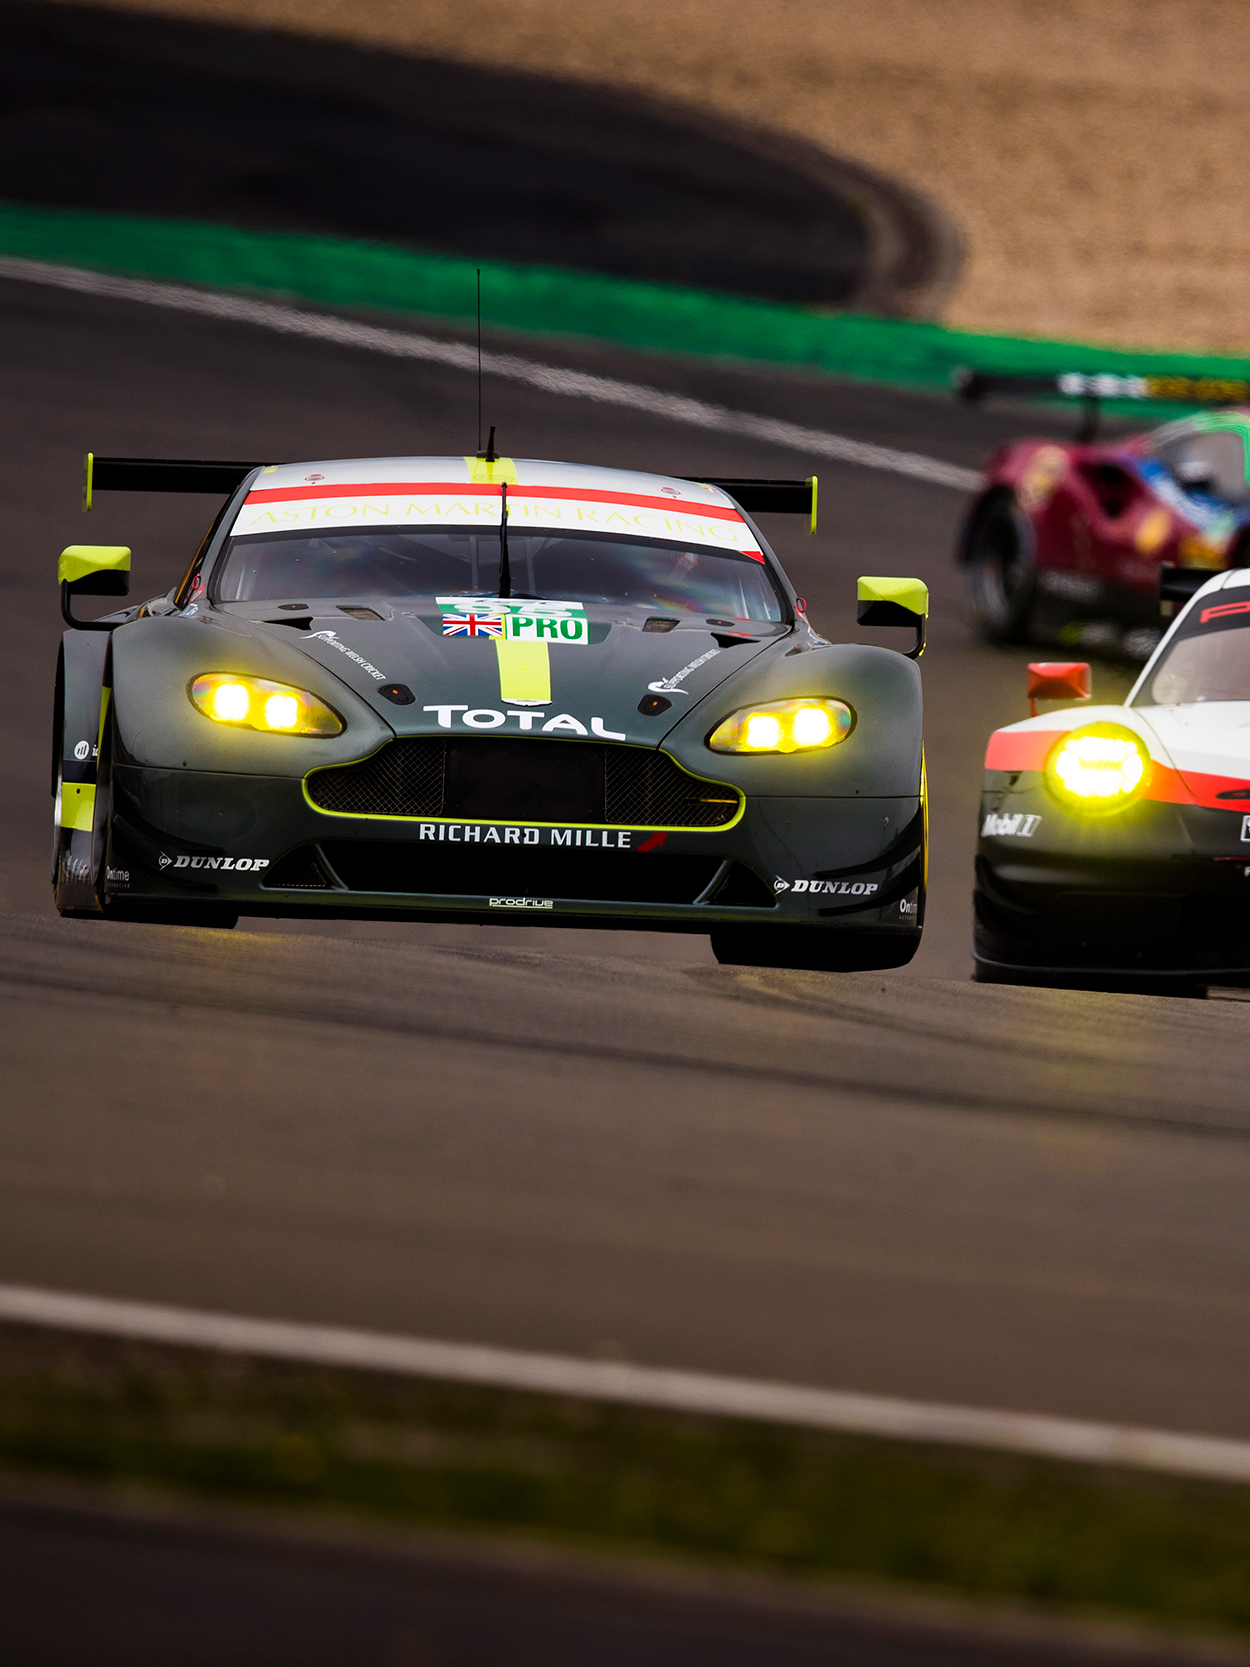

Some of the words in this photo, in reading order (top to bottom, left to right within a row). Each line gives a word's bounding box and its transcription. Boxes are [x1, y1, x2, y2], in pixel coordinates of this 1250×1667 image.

[250, 503, 390, 525] ASTON
[405, 502, 562, 519] MARTIN
[576, 507, 739, 542] RACING
[512, 616, 583, 640] PRO
[422, 704, 627, 741] TOTAL
[419, 823, 541, 845] RICHARD
[550, 829, 632, 848] MILLE
[173, 855, 270, 872] DUNLOP
[791, 880, 879, 896] DUNLOP
